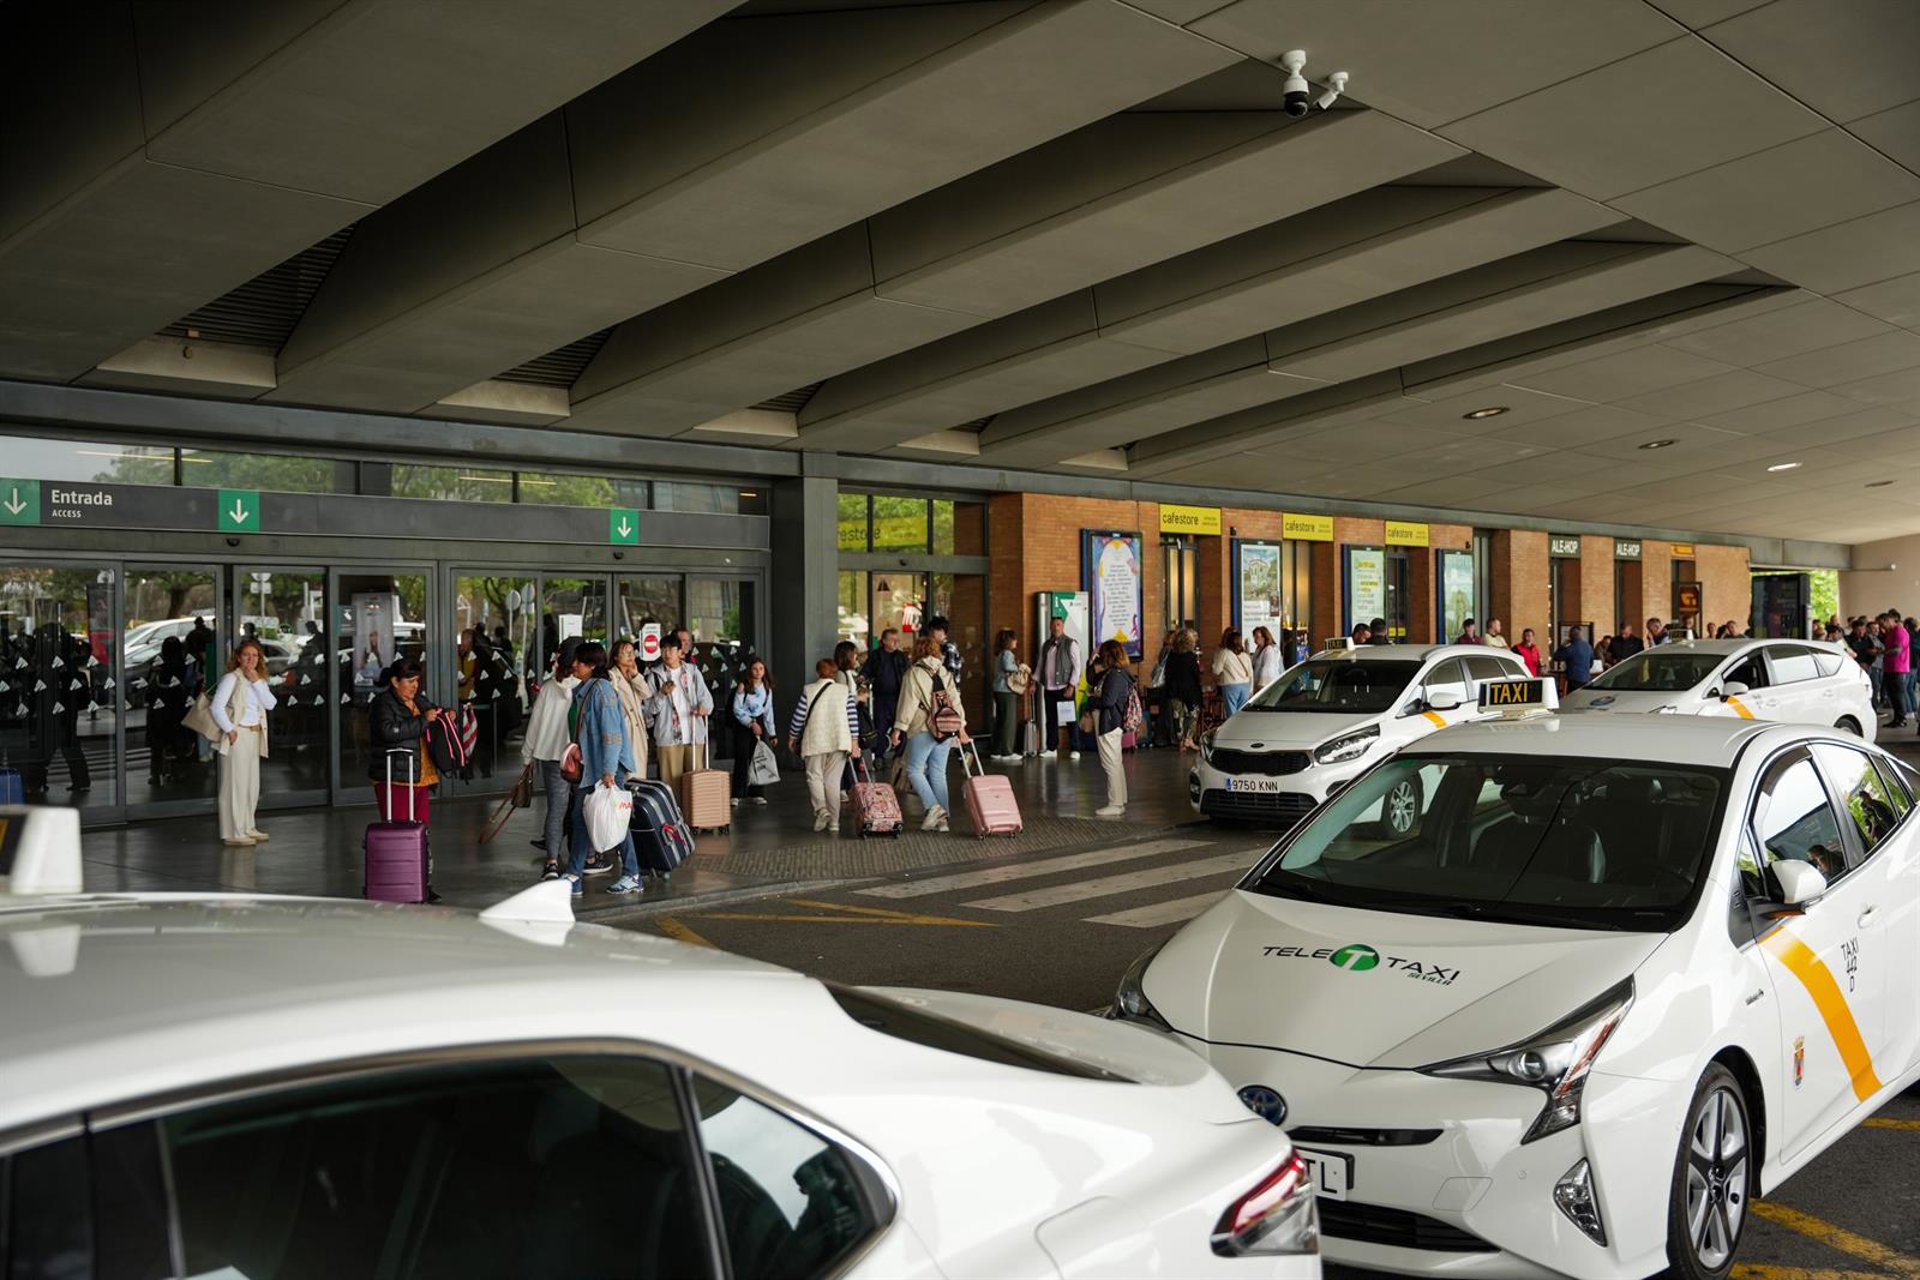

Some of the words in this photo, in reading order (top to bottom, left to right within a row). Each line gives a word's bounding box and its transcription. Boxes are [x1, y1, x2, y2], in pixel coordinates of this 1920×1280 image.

[51, 489, 113, 506] Entrada
[52, 509, 82, 518] ACCESS
[1551, 539, 1579, 554] ALE-HOP
[1616, 543, 1640, 557] ALE-HOP
[1491, 683, 1528, 704] TAXI
[1232, 779, 1256, 791] 9750
[1258, 780, 1279, 792] KNN
[1840, 936, 1860, 961] TAXI
[1263, 946, 1334, 960] TELE
[1386, 956, 1461, 982] TAXI
[1407, 972, 1453, 986] SEVILLA
